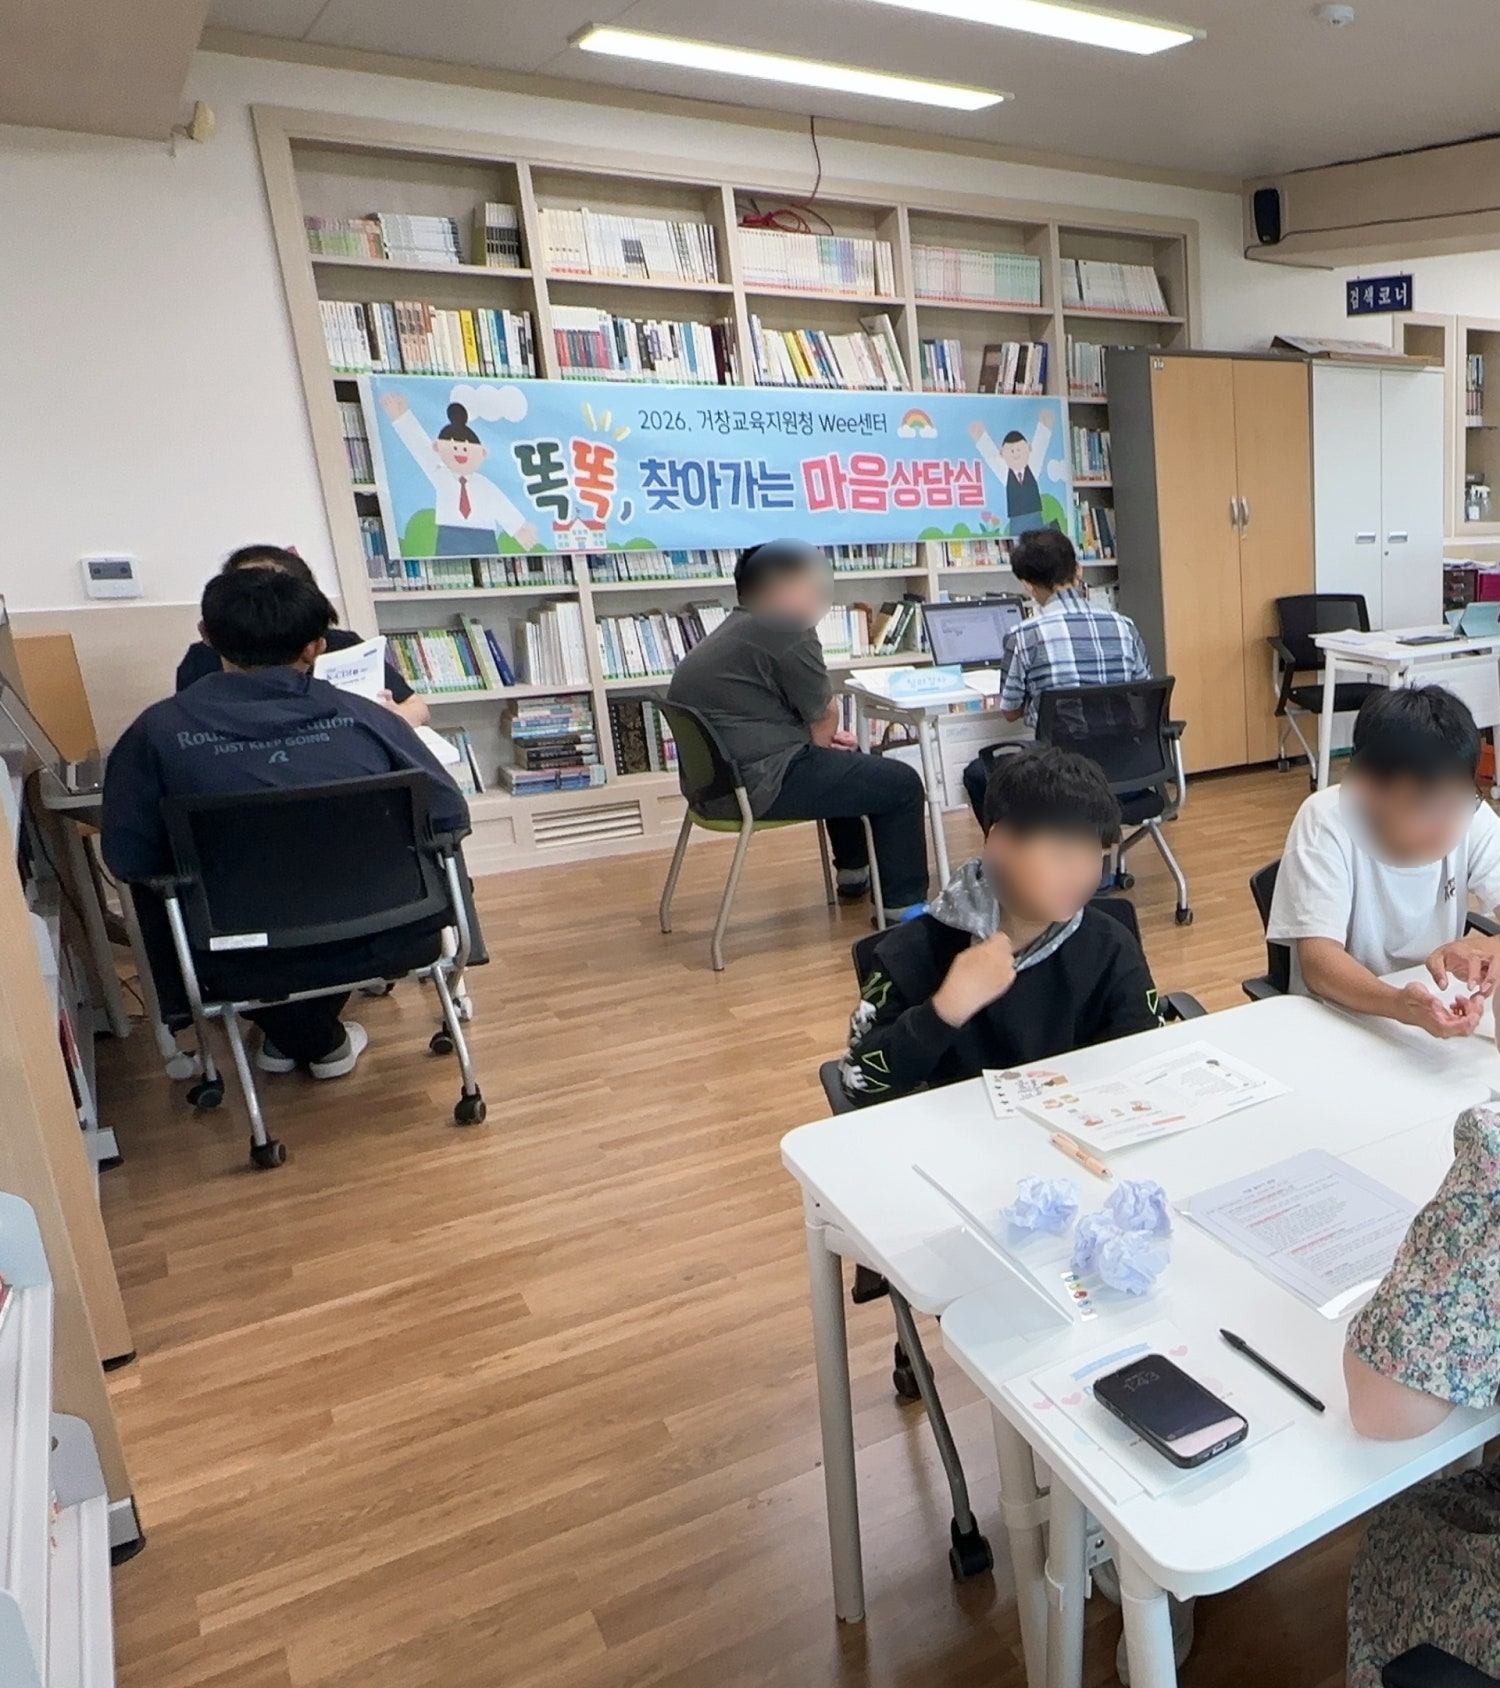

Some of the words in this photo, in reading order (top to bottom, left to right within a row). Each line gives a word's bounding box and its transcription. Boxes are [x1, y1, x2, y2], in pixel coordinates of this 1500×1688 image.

[696, 409, 814, 435] 거창교육지원청
[818, 412, 888, 436] Wee센터
[513, 439, 632, 522] 똑똑,
[639, 458, 794, 511] 찾아가는
[213, 741, 245, 756] JUST
[285, 732, 330, 747] GOING
